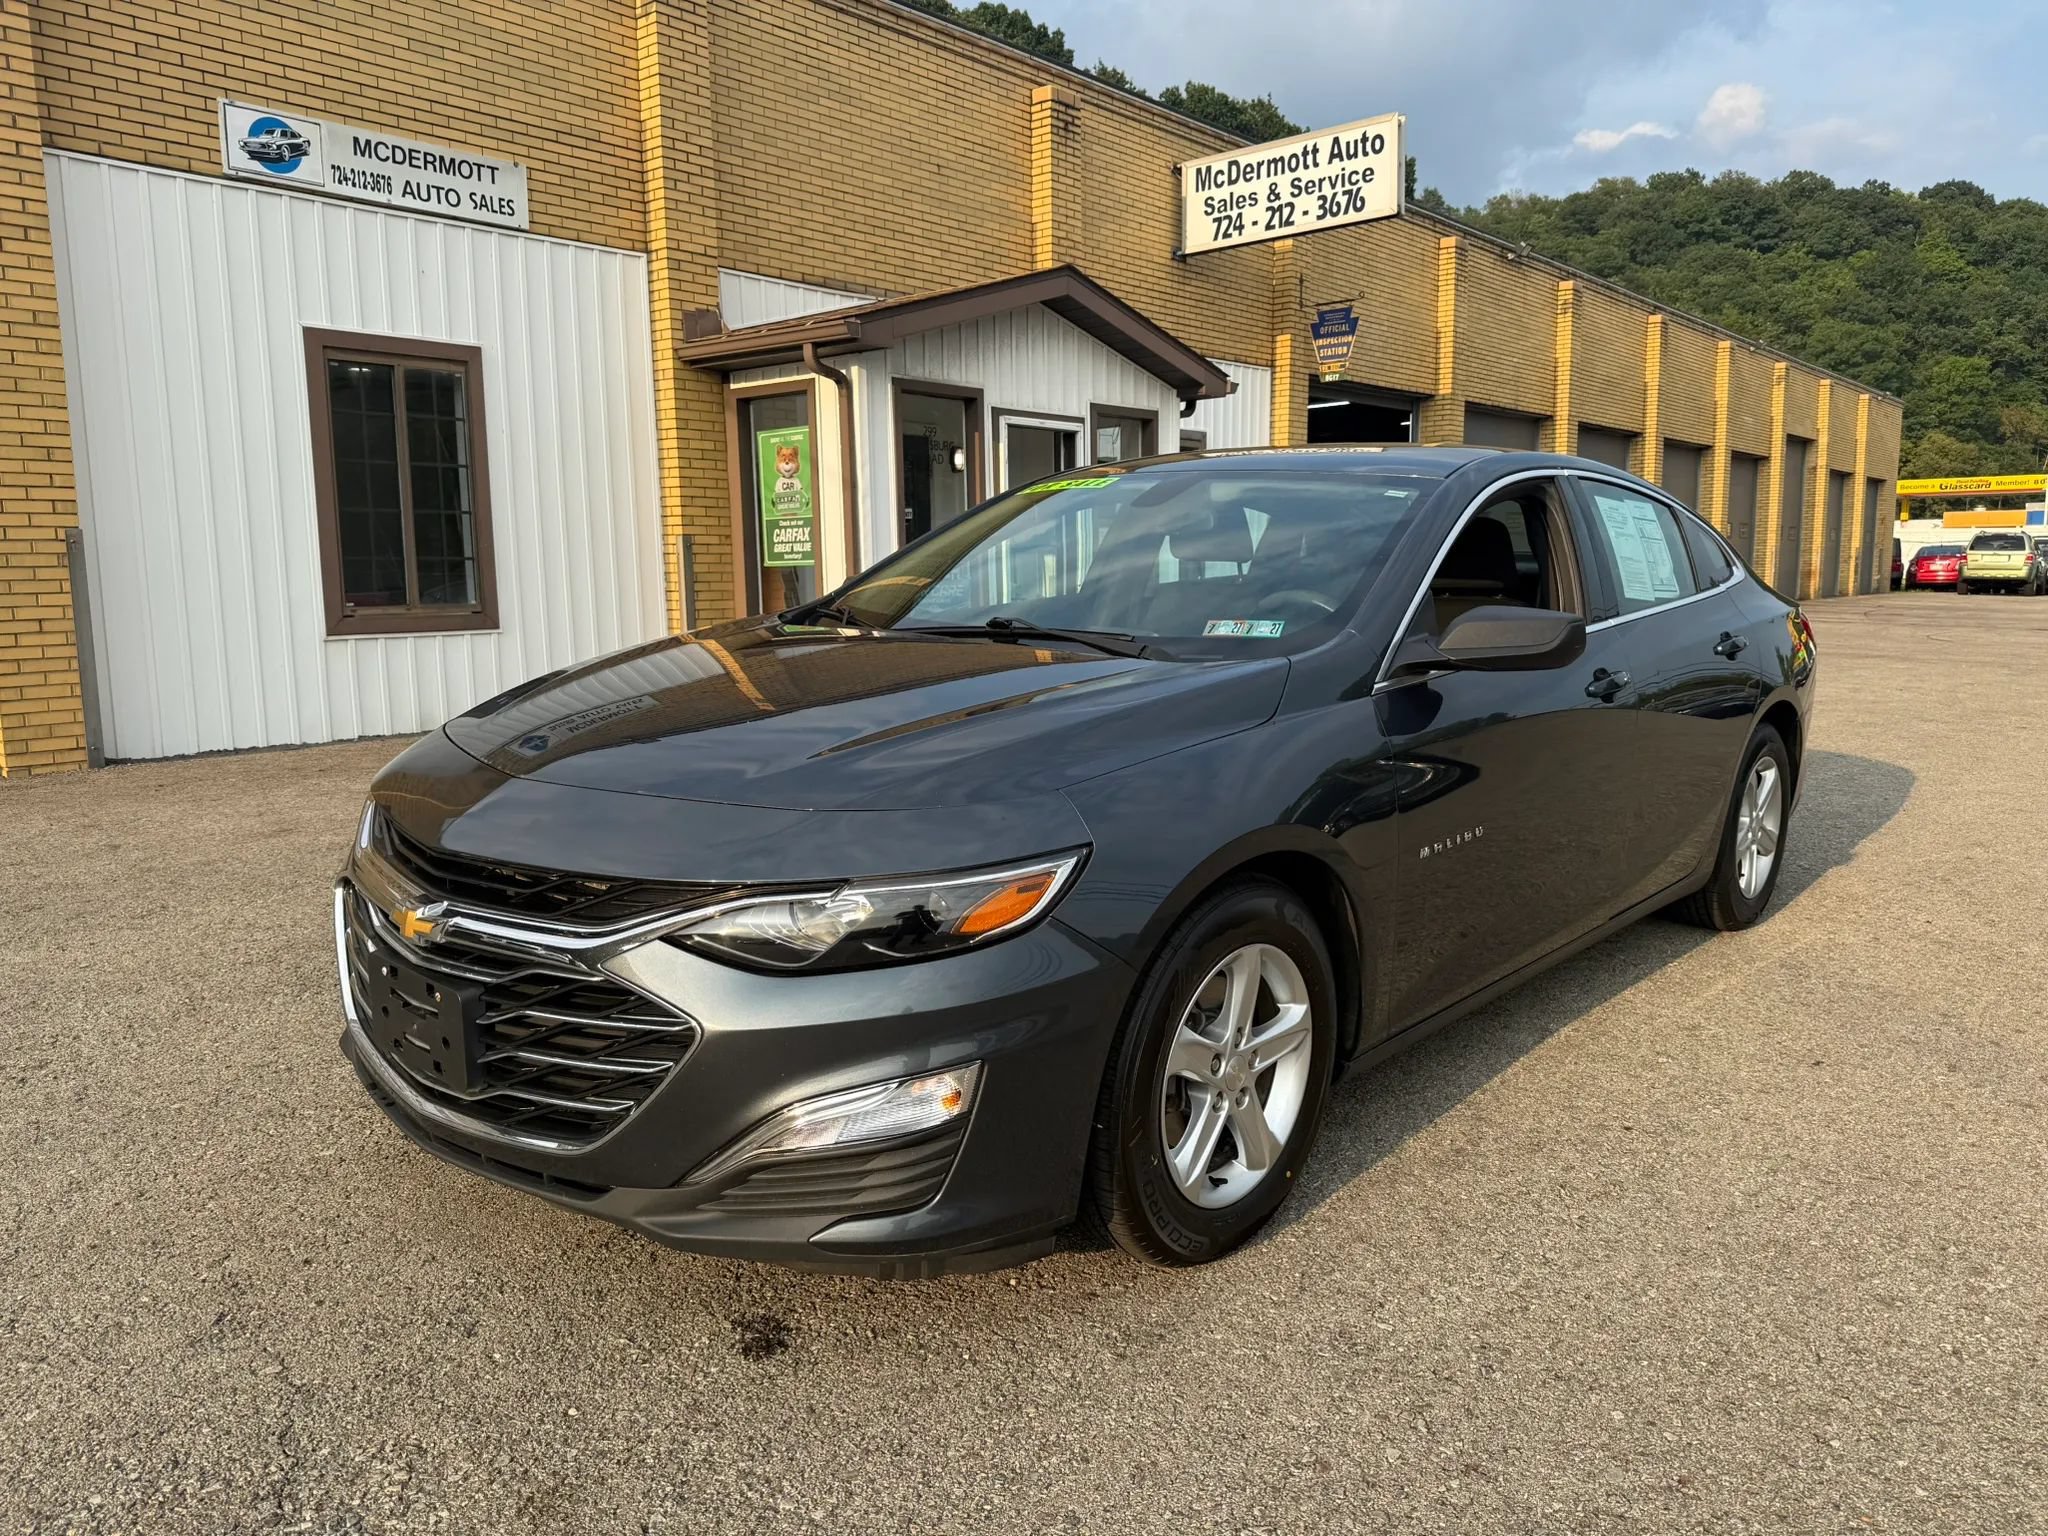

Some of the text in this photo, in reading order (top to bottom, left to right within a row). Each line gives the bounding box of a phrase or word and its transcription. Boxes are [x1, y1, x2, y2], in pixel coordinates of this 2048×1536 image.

[352, 135, 499, 185] MCDERMOTT
[1195, 130, 1385, 193] McDermott Auto
[330, 164, 393, 195] 724-212-3676
[401, 180, 515, 217] AUTO SALES
[1203, 167, 1375, 217] Sales & Service
[1320, 323, 1350, 334] OFFICIAL
[1316, 335, 1352, 345] INSPECTION
[1320, 346, 1347, 356] STATION
[1939, 482, 1991, 490] Glasscard
[1995, 479, 2030, 487] Member!
[773, 527, 811, 543] CARFAX
[774, 542, 812, 553] GREAT VALUE
[1270, 623, 1281, 634] 27
[1419, 826, 1484, 859] MALIBU
